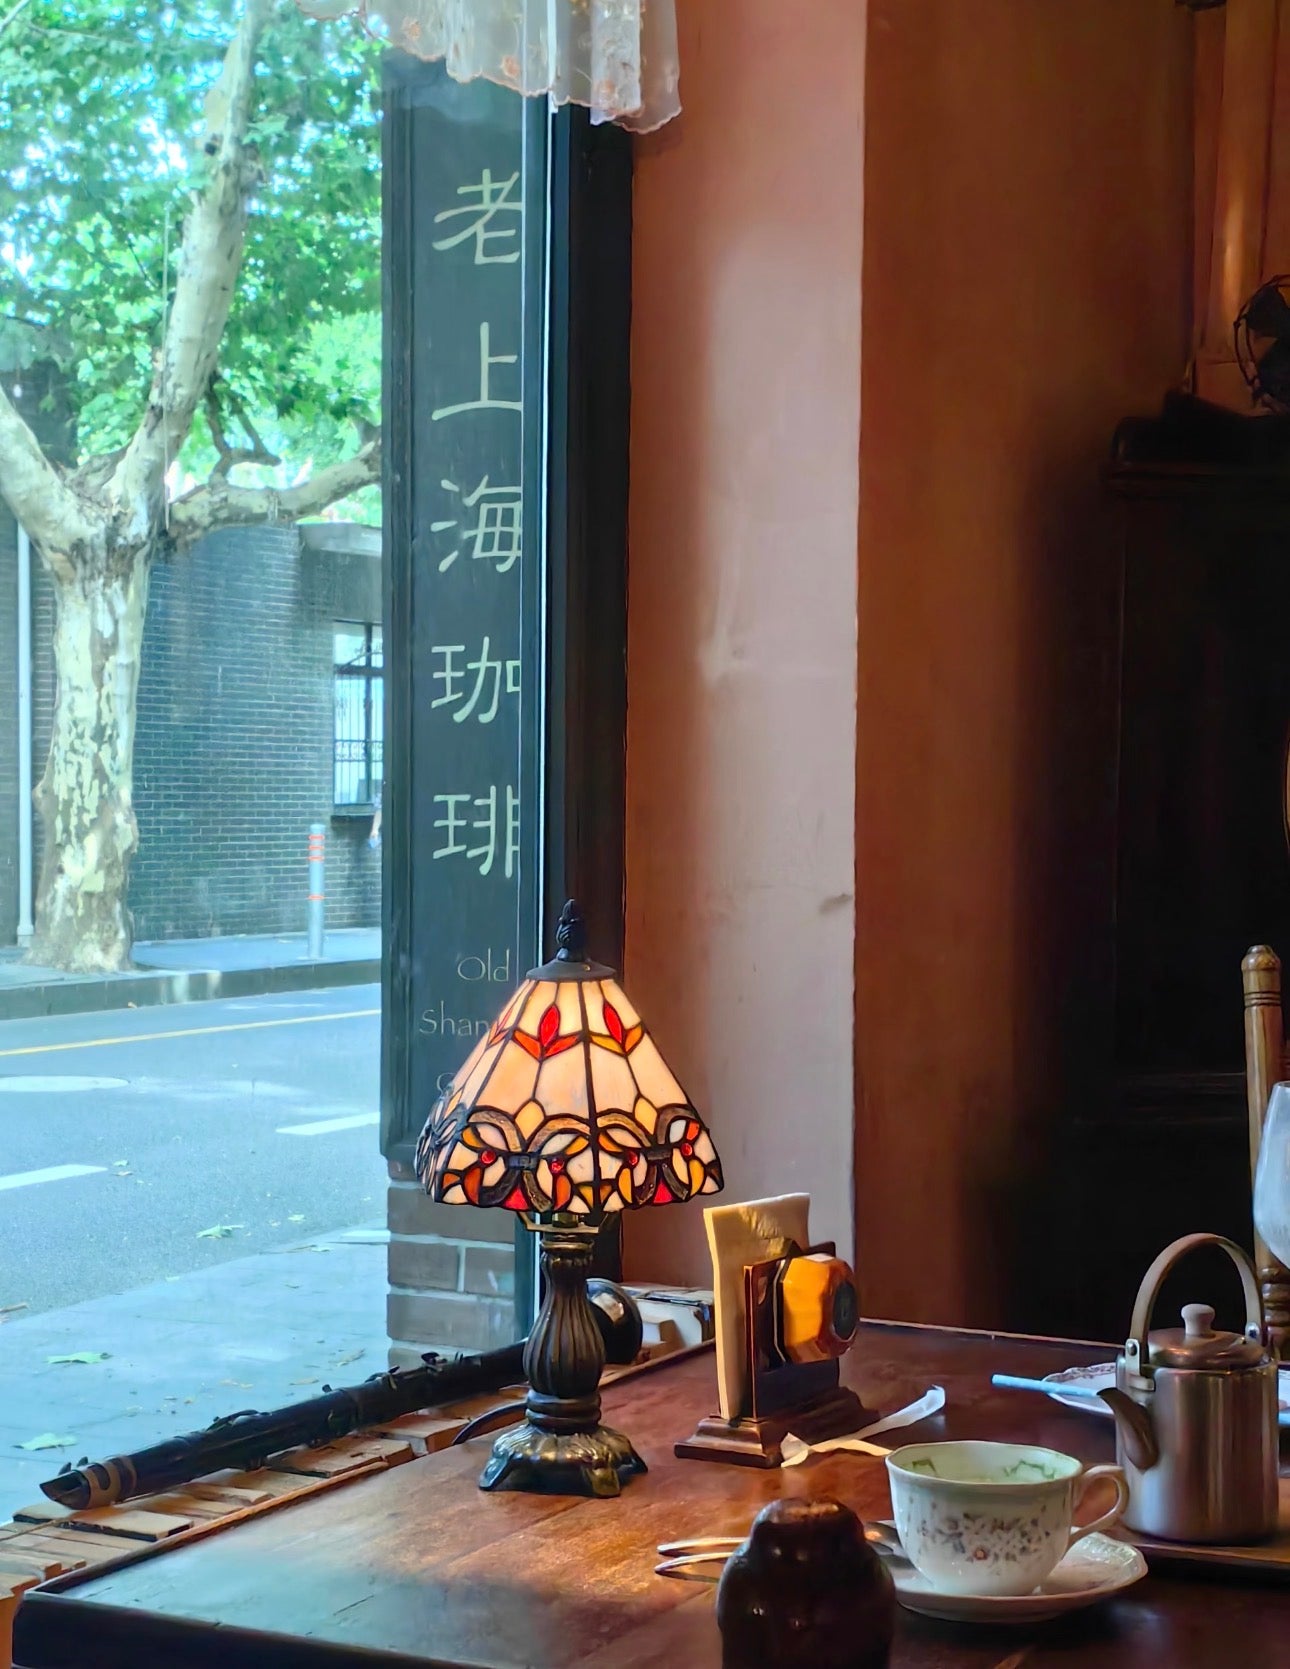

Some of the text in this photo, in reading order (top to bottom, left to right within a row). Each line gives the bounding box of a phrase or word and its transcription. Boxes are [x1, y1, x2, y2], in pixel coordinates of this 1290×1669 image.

[430, 167, 522, 879] 老上海珈琲
[456, 947, 511, 983] Old
